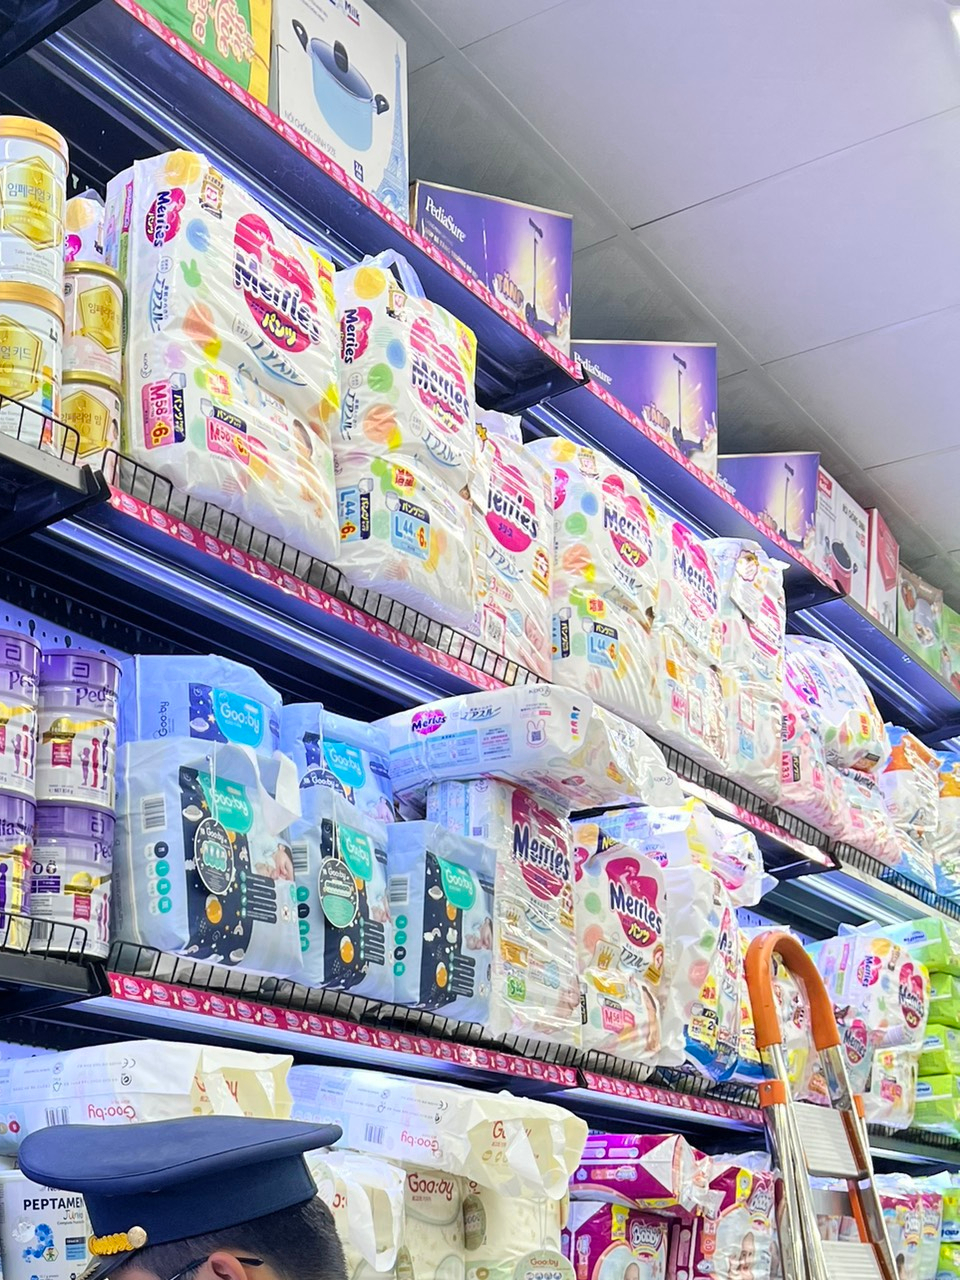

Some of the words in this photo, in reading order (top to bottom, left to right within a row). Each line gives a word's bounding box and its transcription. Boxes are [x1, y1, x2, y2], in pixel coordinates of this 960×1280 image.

[152, 190, 170, 248] Merries
[425, 196, 466, 242] PediaSure
[234, 249, 321, 344] Merries
[262, 312, 297, 347] パンツ
[342, 308, 352, 364] Merries
[220, 702, 260, 735] Goo:by
[512, 822, 571, 881] Merries
[609, 882, 663, 936] Merries
[408, 1171, 455, 1201] Goo:by
[633, 1227, 661, 1245] Bobby
